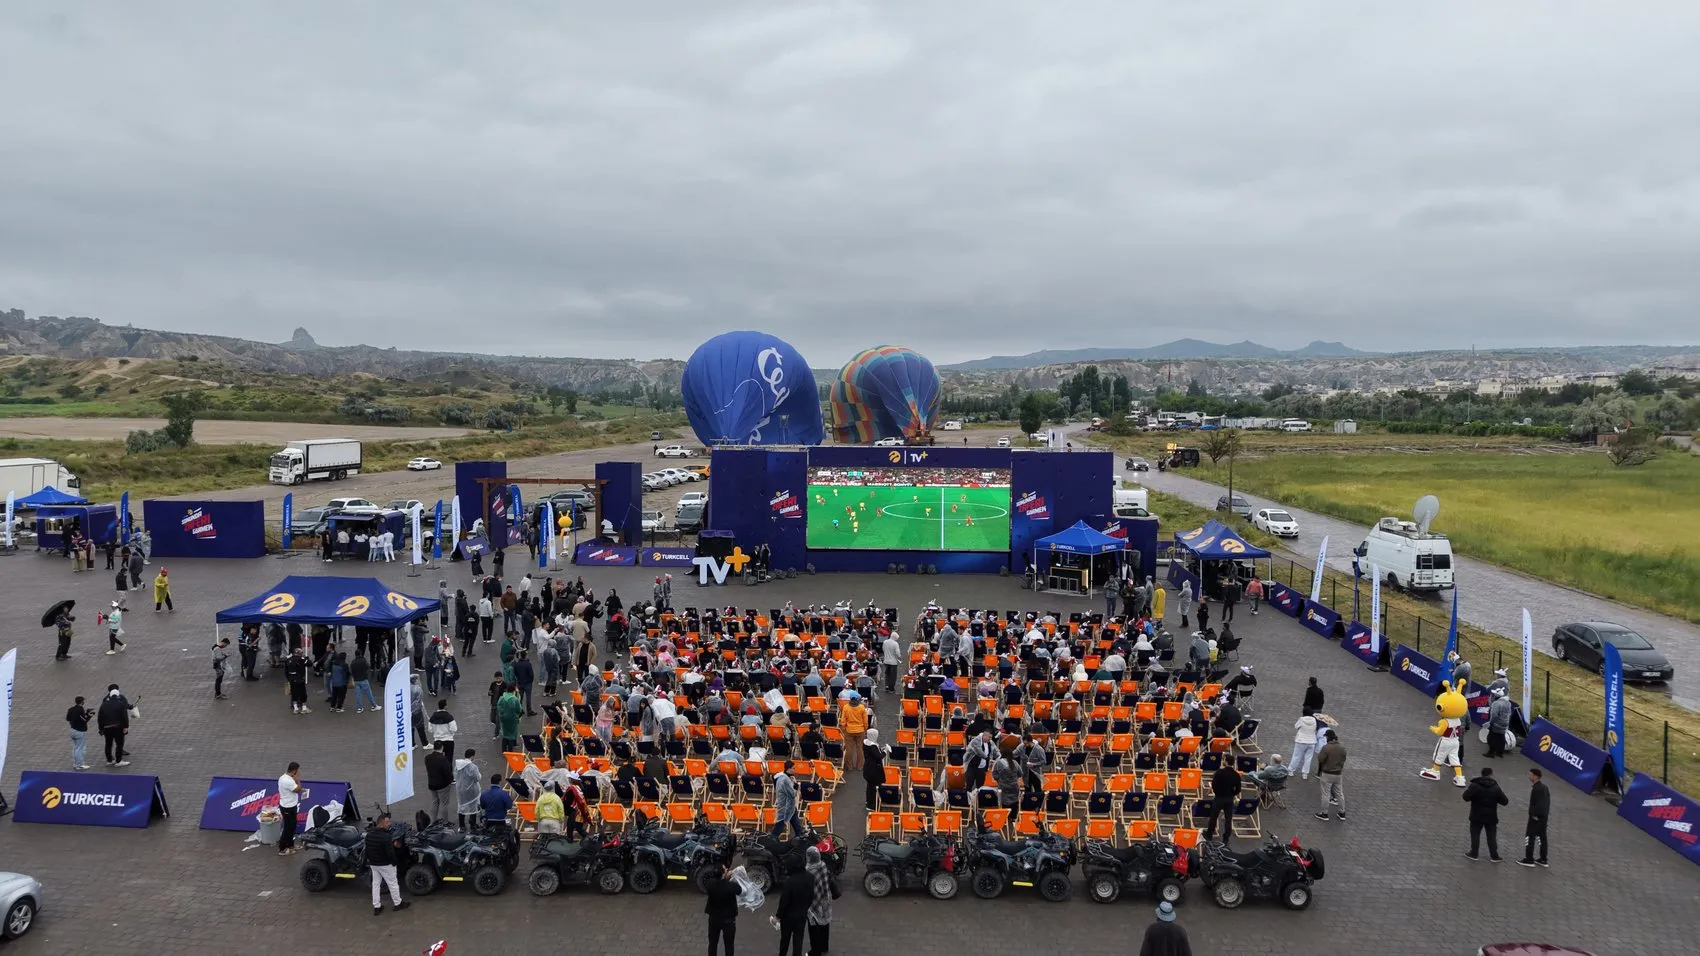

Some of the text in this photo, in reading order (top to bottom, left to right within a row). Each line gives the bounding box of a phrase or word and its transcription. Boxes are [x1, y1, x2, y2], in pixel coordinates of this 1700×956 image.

[910, 451, 928, 462] TV+
[692, 546, 750, 584] TV+
[1408, 662, 1431, 681] TURKCELL
[1608, 671, 1618, 728] TURKCELL
[395, 688, 406, 752] TURKCELL
[1549, 742, 1584, 770] TURKCELL
[62, 793, 125, 807] TURKCELL
[230, 788, 267, 810] SONUNDA
